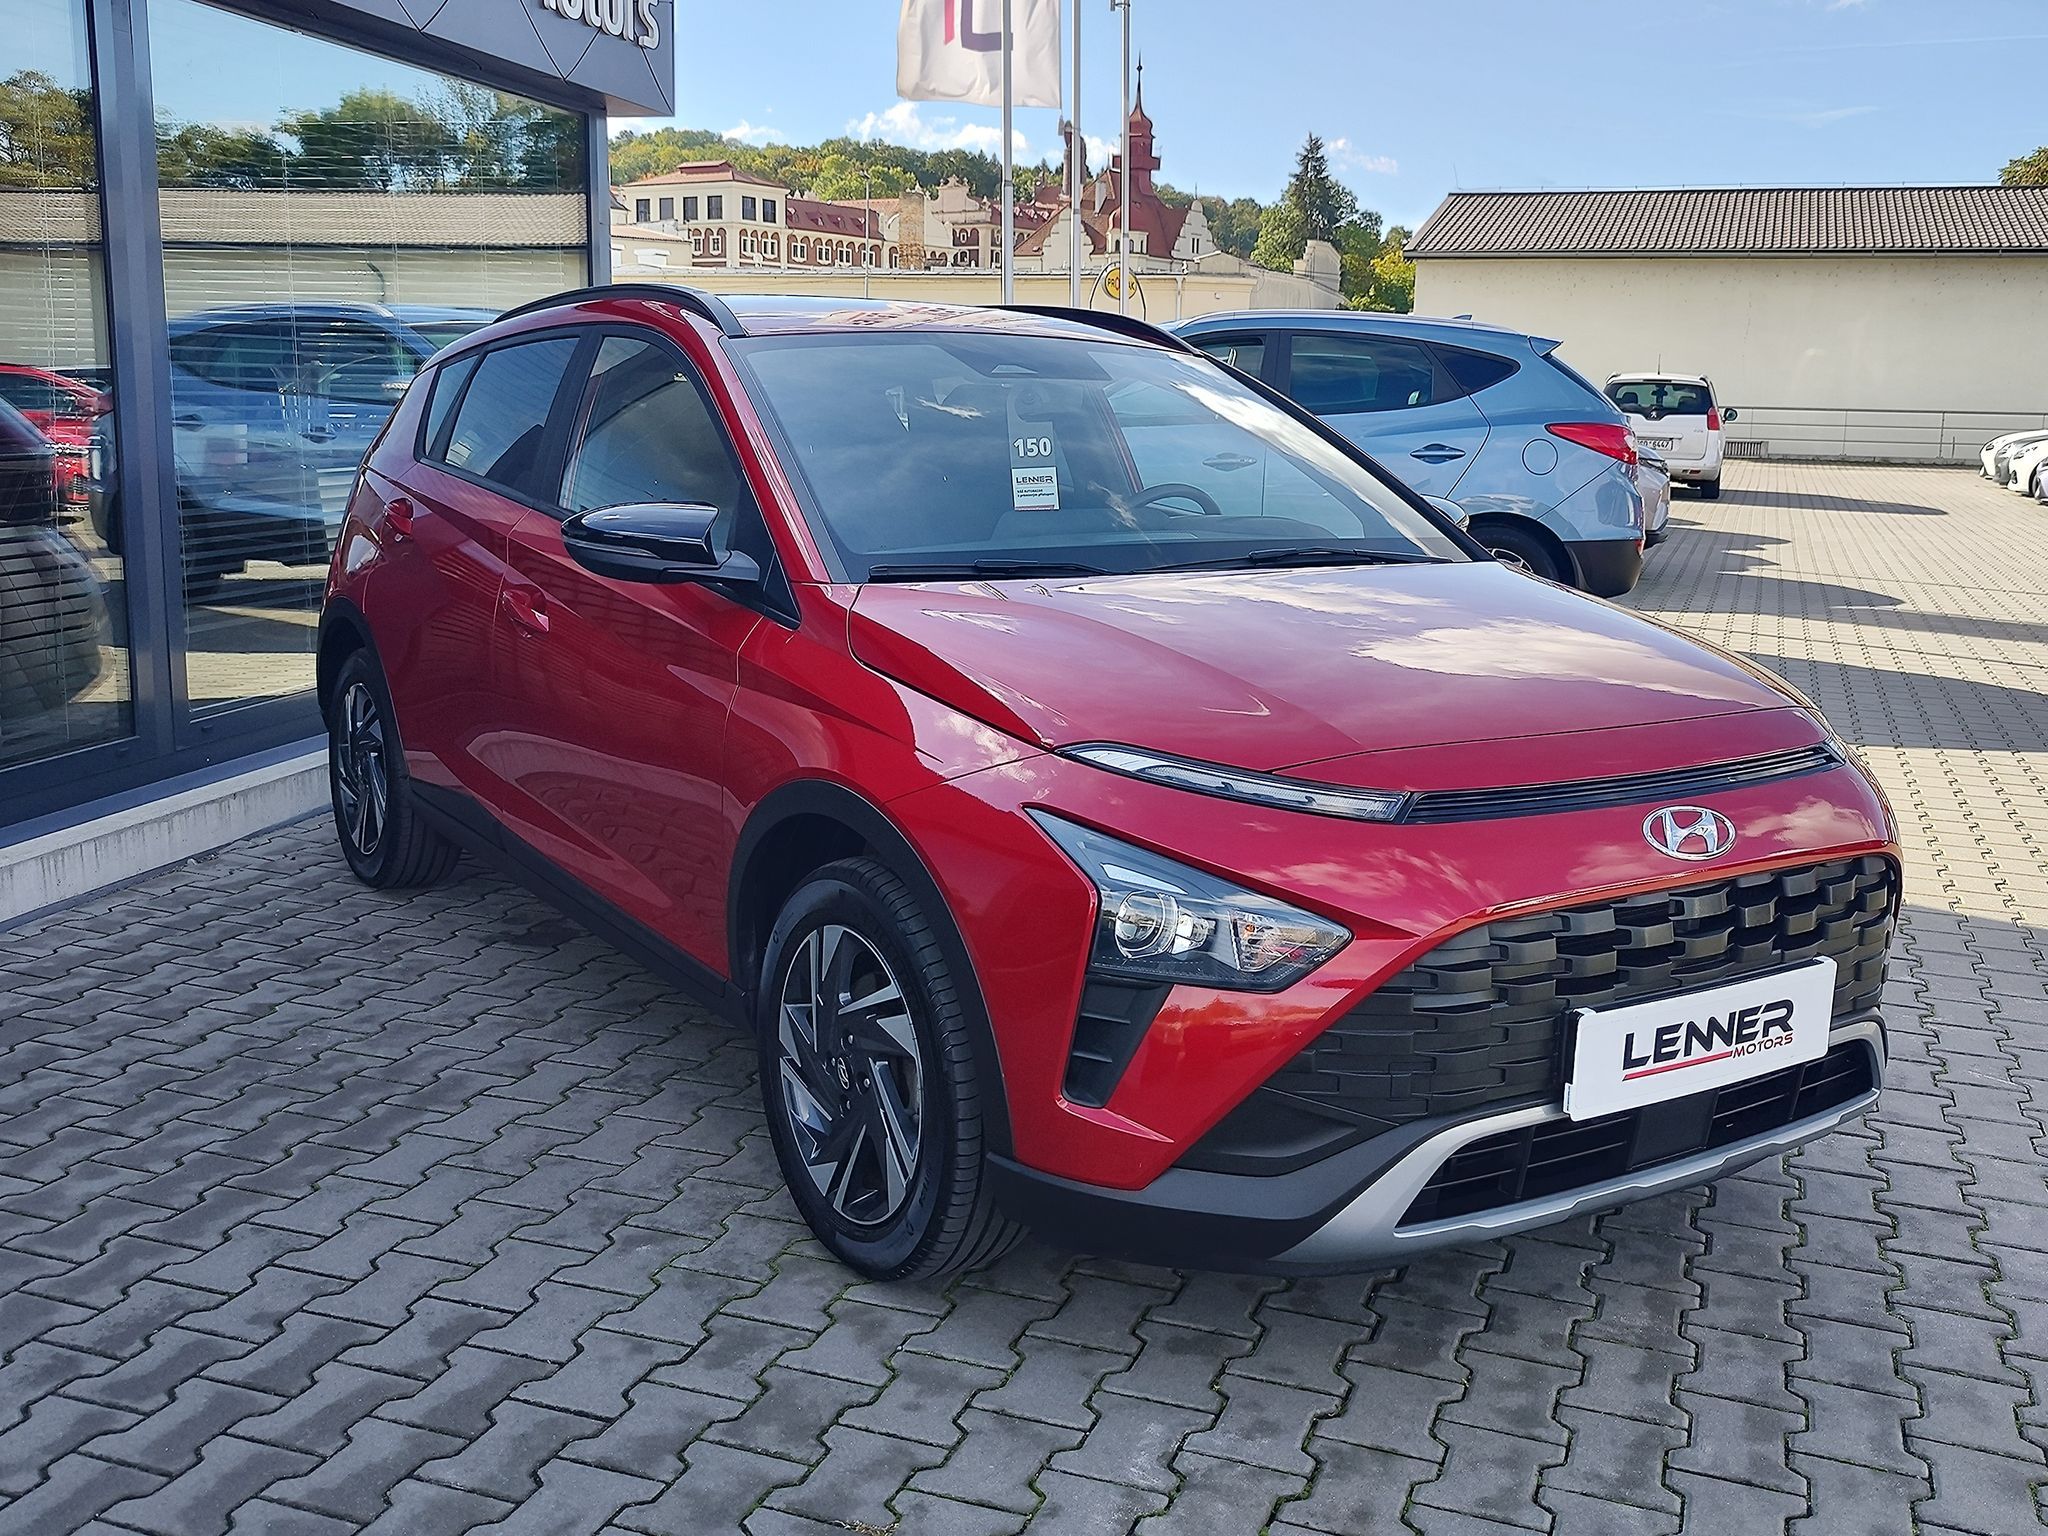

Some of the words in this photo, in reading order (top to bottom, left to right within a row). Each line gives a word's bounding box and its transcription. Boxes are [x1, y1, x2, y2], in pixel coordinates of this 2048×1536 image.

[1013, 437, 1053, 457] 150
[1016, 475, 1054, 485] LENNER
[1622, 999, 1794, 1070] LENNER
[1731, 1033, 1794, 1059] MOTORS
